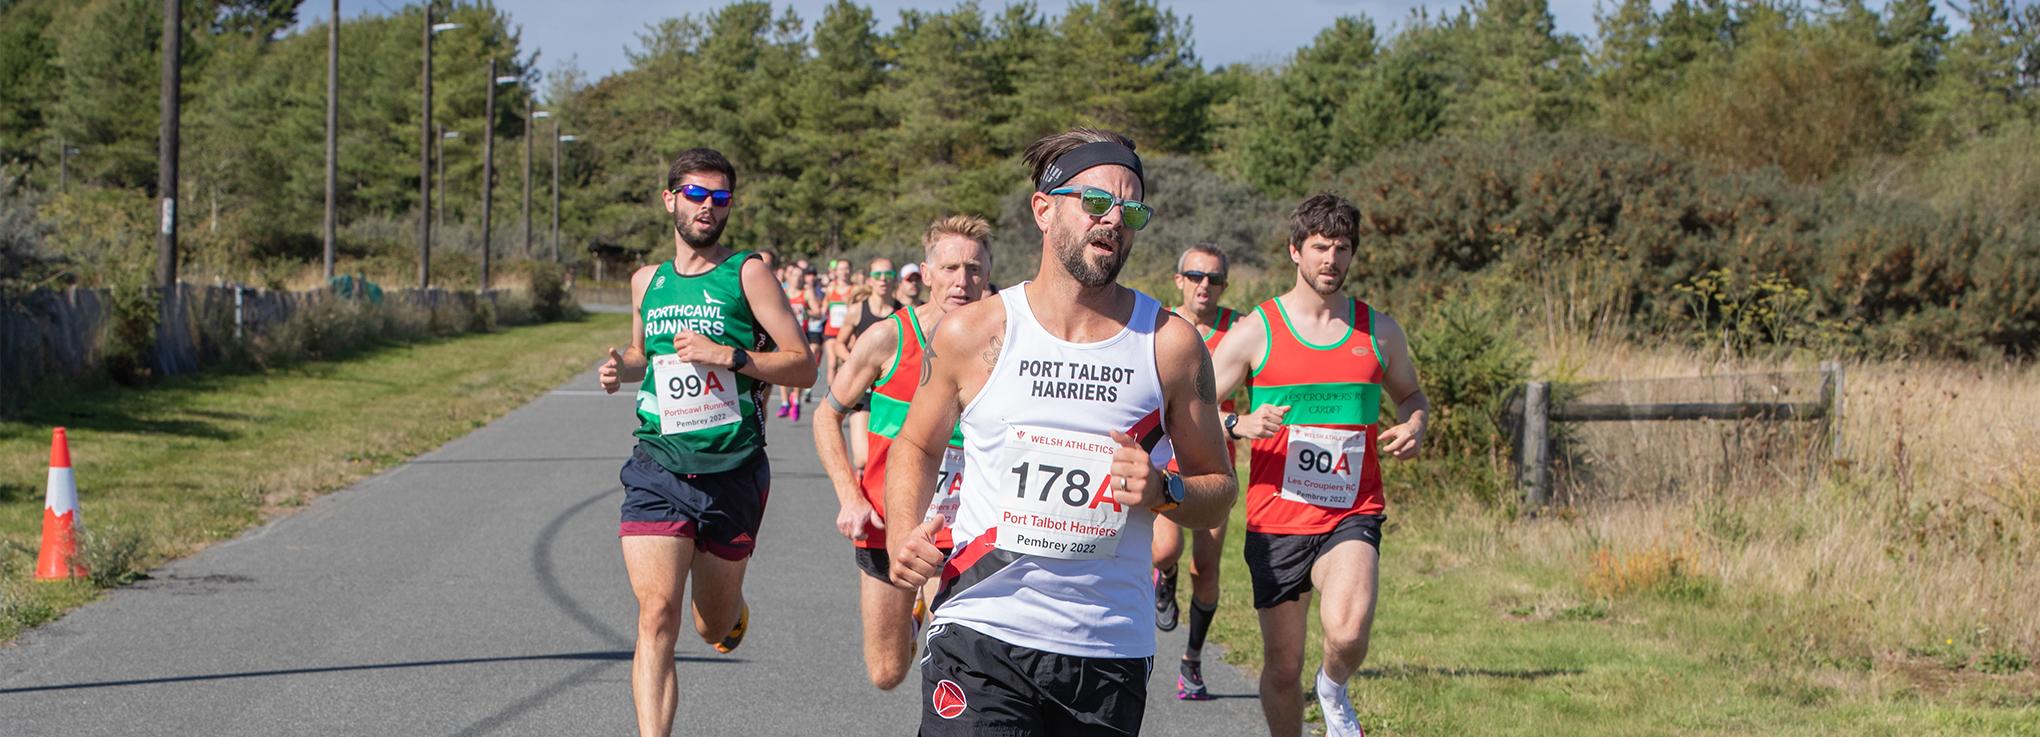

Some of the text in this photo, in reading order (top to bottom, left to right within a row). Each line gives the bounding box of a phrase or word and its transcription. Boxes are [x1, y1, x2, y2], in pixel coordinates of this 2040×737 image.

[646, 304, 725, 321] PORTHCAWL
[645, 319, 725, 338] RUNNERS
[1018, 359, 1134, 385] PORT TALBOT
[668, 370, 725, 400] 99A
[1031, 380, 1118, 403] HARRIERS
[664, 400, 735, 417] Porthcawl Runners
[676, 413, 727, 428] Pembrey 2022
[1031, 435, 1115, 455] WELSH ATHLETICS
[1298, 449, 1351, 475] 90A
[1011, 461, 1122, 513] 178A
[1287, 476, 1302, 485] Les
[1303, 479, 1344, 491] Croupiers
[1296, 490, 1347, 503] Pembrey 2022
[1003, 511, 1117, 538] Port Talbot Harriers
[1017, 534, 1097, 554] Pembrey 2022
